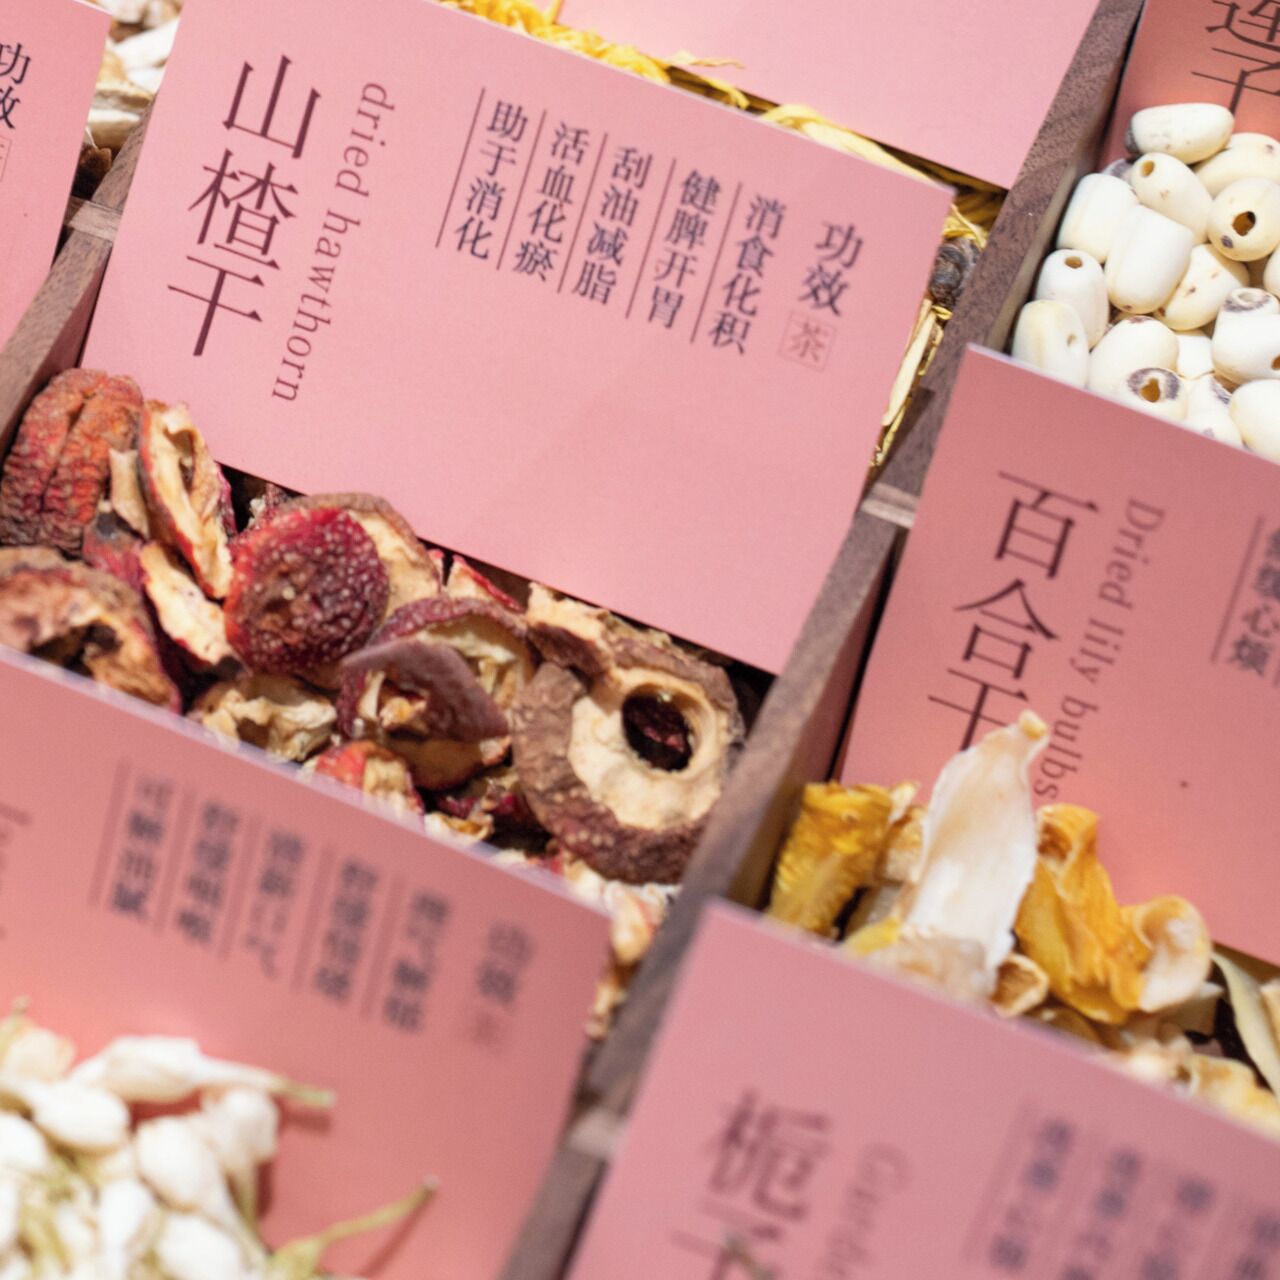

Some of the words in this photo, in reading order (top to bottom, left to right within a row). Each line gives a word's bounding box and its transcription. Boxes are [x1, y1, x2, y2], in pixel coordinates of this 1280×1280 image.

[166, 54, 321, 357] 山楂干
[335, 80, 396, 198] dried
[453, 98, 529, 265] 助于消化
[512, 120, 591, 286] 活血化瘀
[572, 144, 653, 305] 刮油减脂
[646, 167, 722, 330] 健脾开胃
[709, 192, 787, 357] 消食化积
[801, 220, 864, 317] 功效
[271, 210, 361, 404] hawthorn
[927, 470, 1100, 751] 百合干
[1098, 497, 1166, 611] Dried
[1069, 617, 1125, 685] lily
[1034, 694, 1098, 800] bulbs
